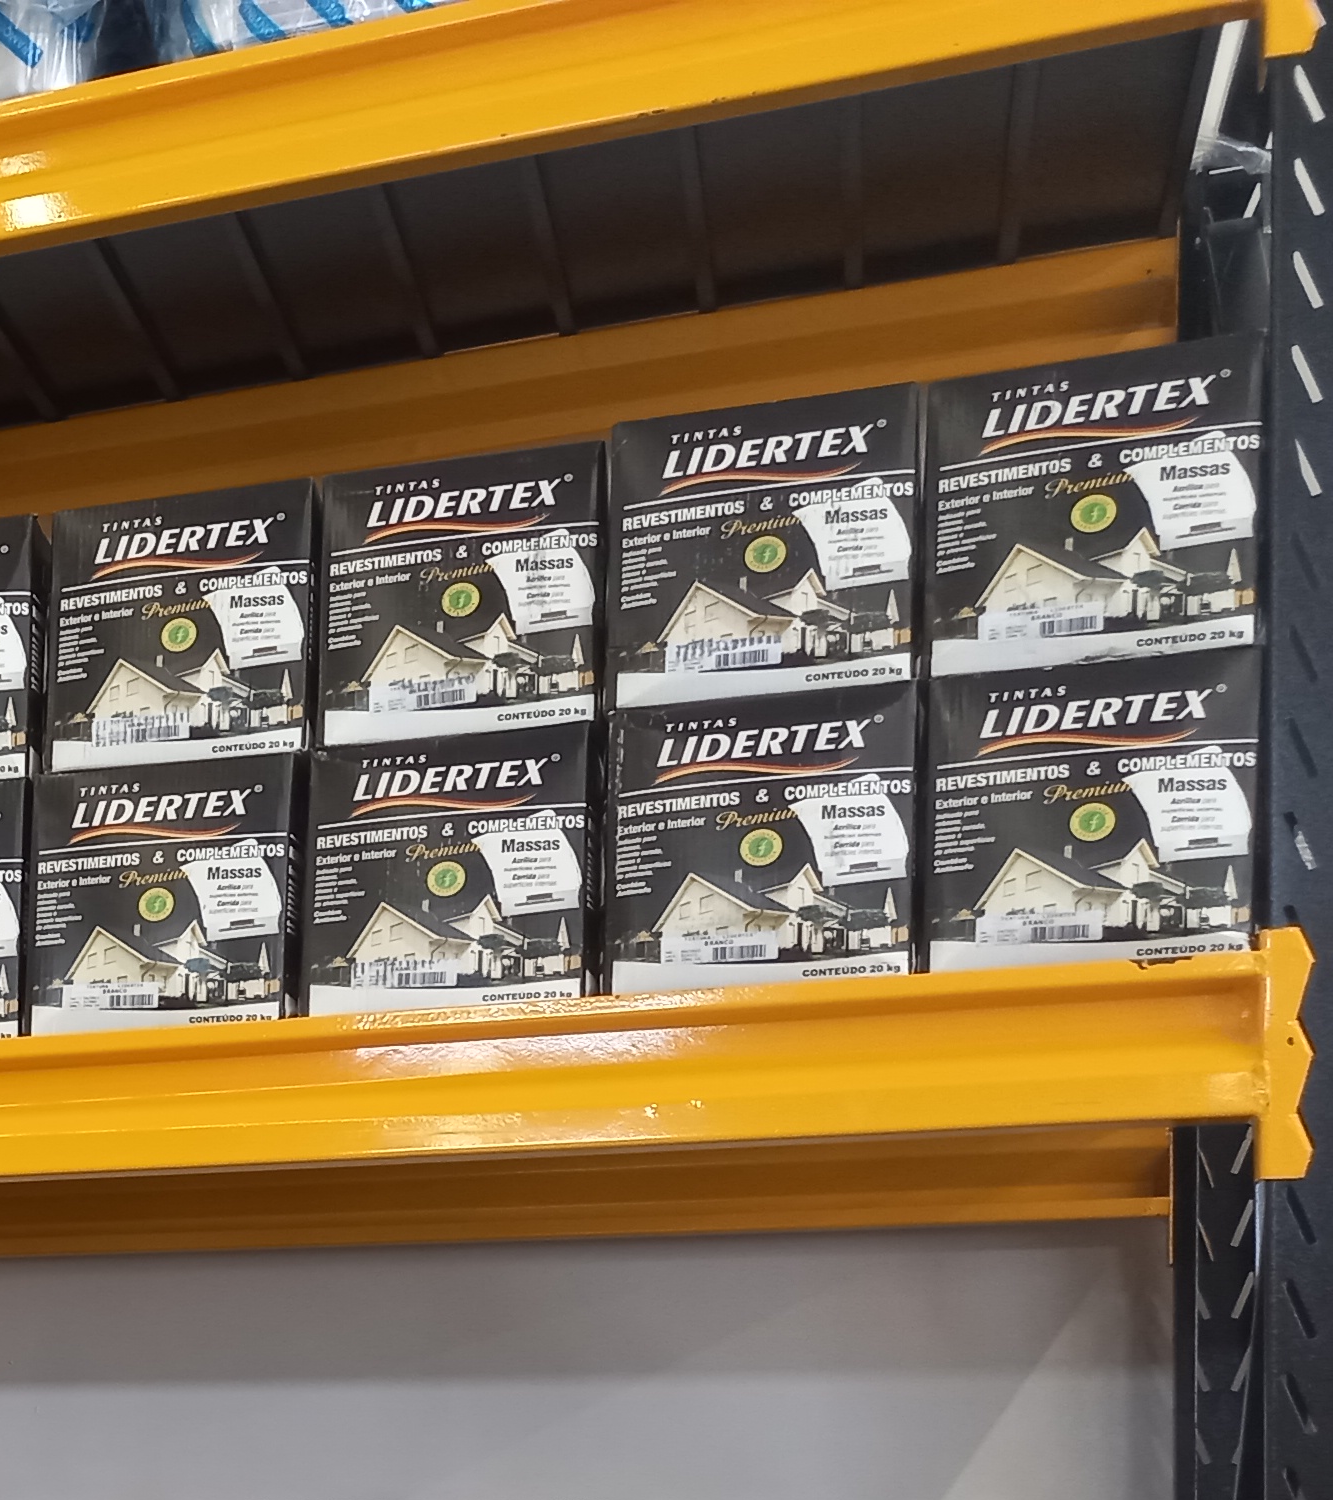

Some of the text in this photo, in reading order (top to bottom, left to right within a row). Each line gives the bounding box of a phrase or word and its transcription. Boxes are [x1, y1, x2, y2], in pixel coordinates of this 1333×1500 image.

[982, 375, 1215, 438] LIDERTEX
[992, 380, 1069, 402] TINTAS
[938, 434, 1260, 493] REVESTIMENTOS & COMPLEMENTOS
[1160, 459, 1230, 481] Massas
[366, 479, 559, 529] LIDERTEX
[938, 494, 980, 511] Exterior
[993, 486, 1034, 500] Interior
[93, 519, 271, 564] LIDERTEX
[515, 555, 574, 573] Massas
[1136, 629, 1245, 648] CONTEÚDO 20 kg
[806, 666, 902, 682] CONTEÚDO 20 kg
[989, 685, 1067, 703] TINTAS
[980, 689, 1210, 740] LIDERTEX
[657, 719, 870, 766] LIDERTEX
[353, 759, 547, 802] LIDERTEX
[617, 778, 911, 818] REVESTIMENTOS & COMPLEMENTOS
[71, 790, 250, 829] LIDERTEX
[500, 836, 560, 853] Massas
